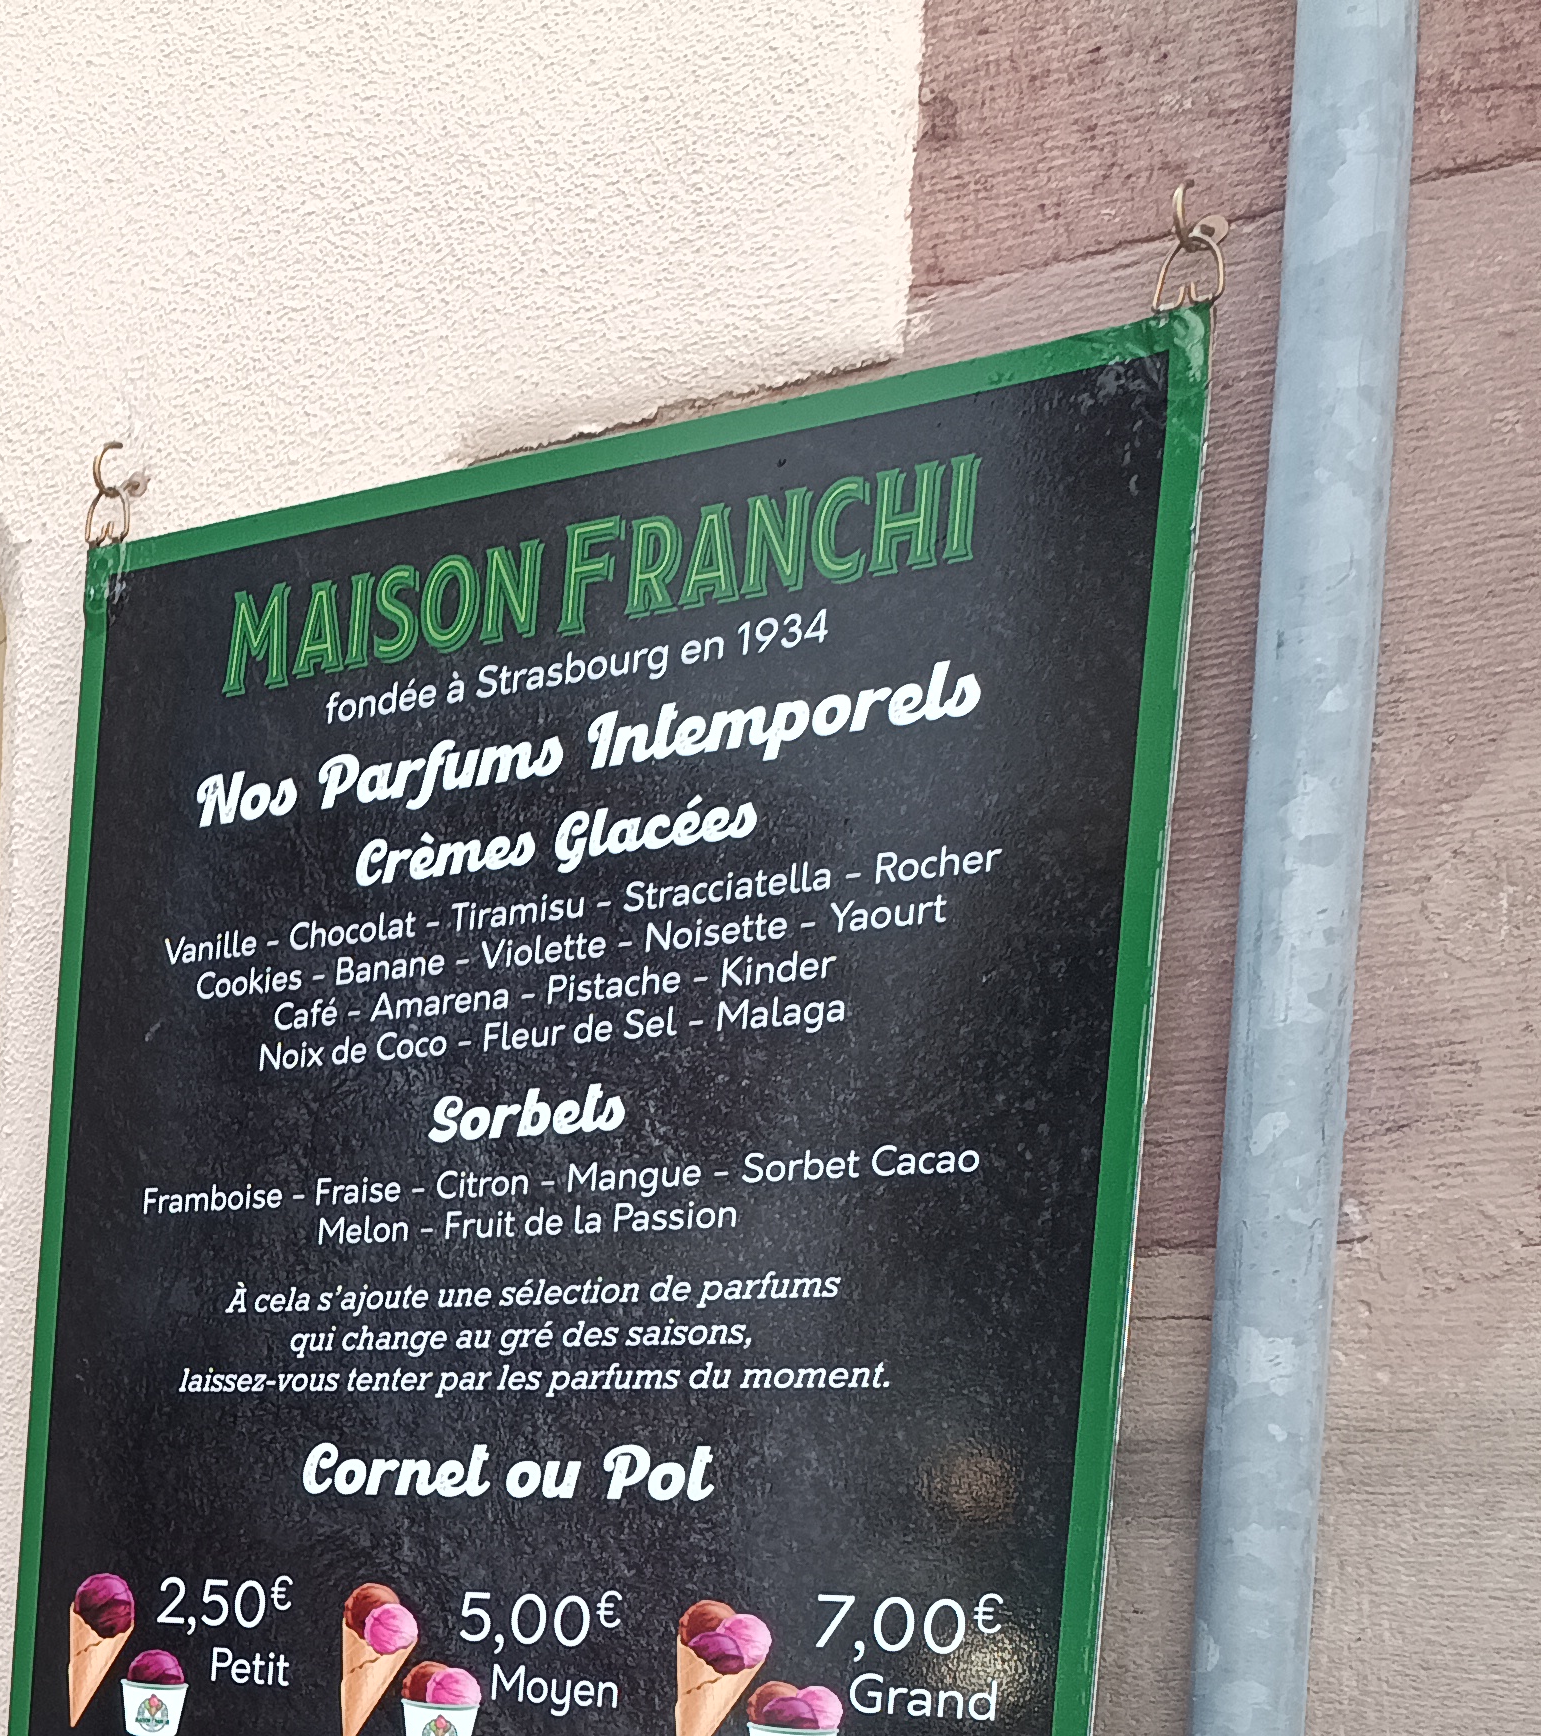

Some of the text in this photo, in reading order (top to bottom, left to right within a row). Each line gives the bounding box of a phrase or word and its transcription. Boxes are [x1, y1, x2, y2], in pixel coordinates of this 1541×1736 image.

[223, 454, 981, 697] MAISON FRANCHI
[326, 609, 828, 724] fondée à Strasbourg en 1934
[197, 660, 981, 828] Nos Parfums Intemporels
[356, 794, 757, 886] Crèmes Glacées
[165, 845, 1002, 964] Vanille Chocolat Tiramisu Stracciatella Rocher
[197, 894, 947, 999] Cookies Banane Violette Noisette Yaourt
[275, 951, 837, 1030] Café Amarena Pistache Kinder
[259, 997, 845, 1071] Noix de Coco Fleur de Sel Malaga
[428, 1083, 625, 1143] Sorbets
[144, 1145, 979, 1214] Framboise Fraise Citron Mangue Sorbet Cacao
[318, 1201, 736, 1245] Melon Fruit de la Passion
[225, 1282, 247, 1313] À
[255, 1287, 310, 1312] cela
[438, 1288, 491, 1307] une
[499, 1277, 639, 1306] sélection
[650, 1275, 691, 1302] de
[696, 1271, 841, 1308] parfums
[290, 1318, 751, 1358] qui change au gré des saisons,
[179, 1362, 889, 1398] laissez-vous tenter par les parfums du moment.
[303, 1443, 714, 1501] Cornet ou Pot
[157, 1576, 293, 1633] 2,50€
[460, 1591, 622, 1652] 5,00€
[816, 1593, 1004, 1660] 7,00€
[209, 1645, 289, 1686] Petit
[491, 1665, 618, 1716] Moyen
[850, 1674, 999, 1721] Grand
